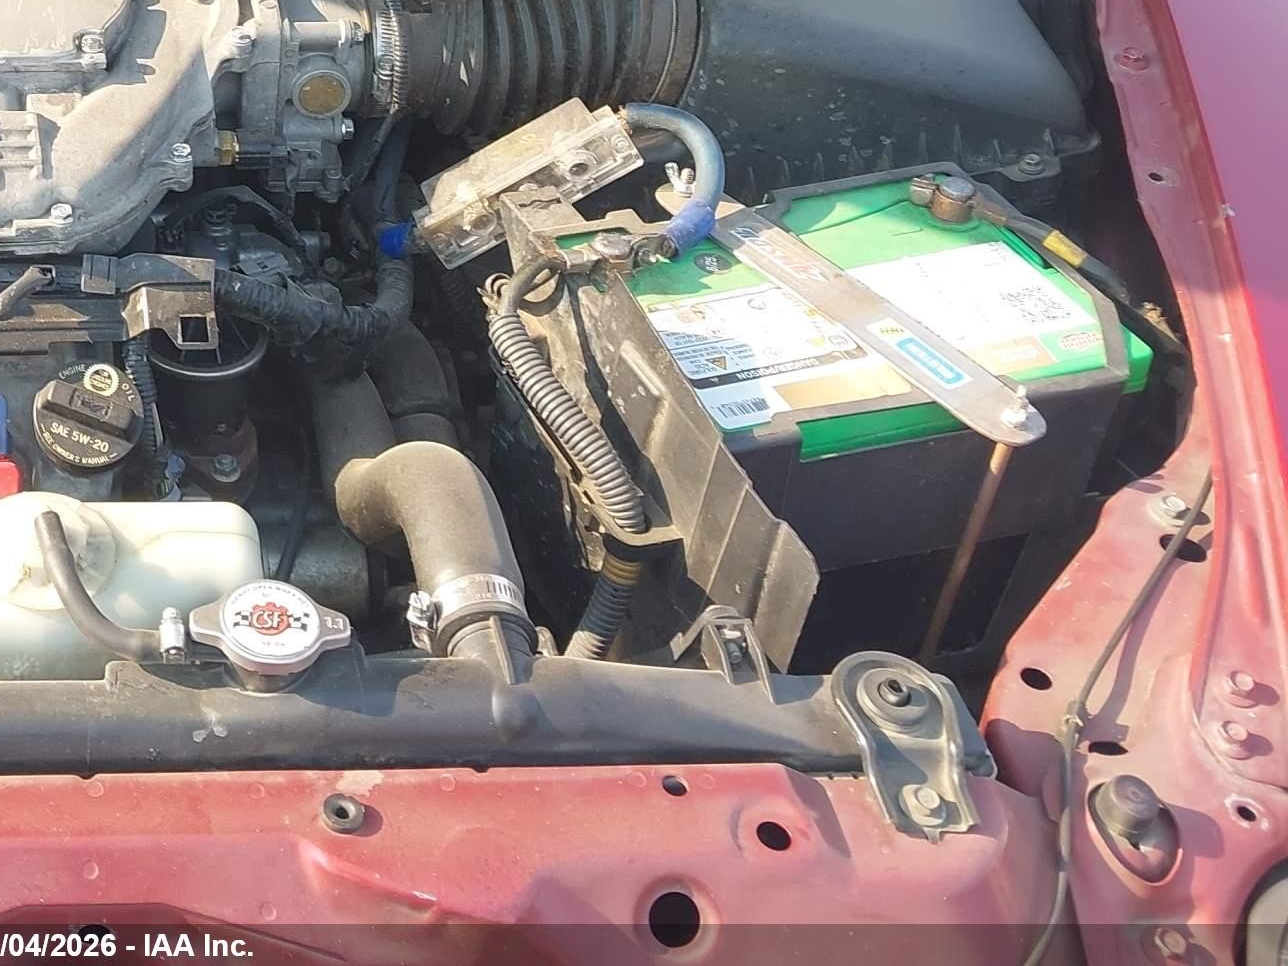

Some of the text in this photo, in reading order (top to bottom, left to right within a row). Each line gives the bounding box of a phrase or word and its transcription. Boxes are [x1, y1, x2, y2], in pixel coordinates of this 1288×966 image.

[58, 363, 136, 402] ENGINE OIL
[50, 422, 110, 453] SAE 5W-20
[81, 455, 110, 465] MANUAL
[252, 609, 284, 630] CSF
